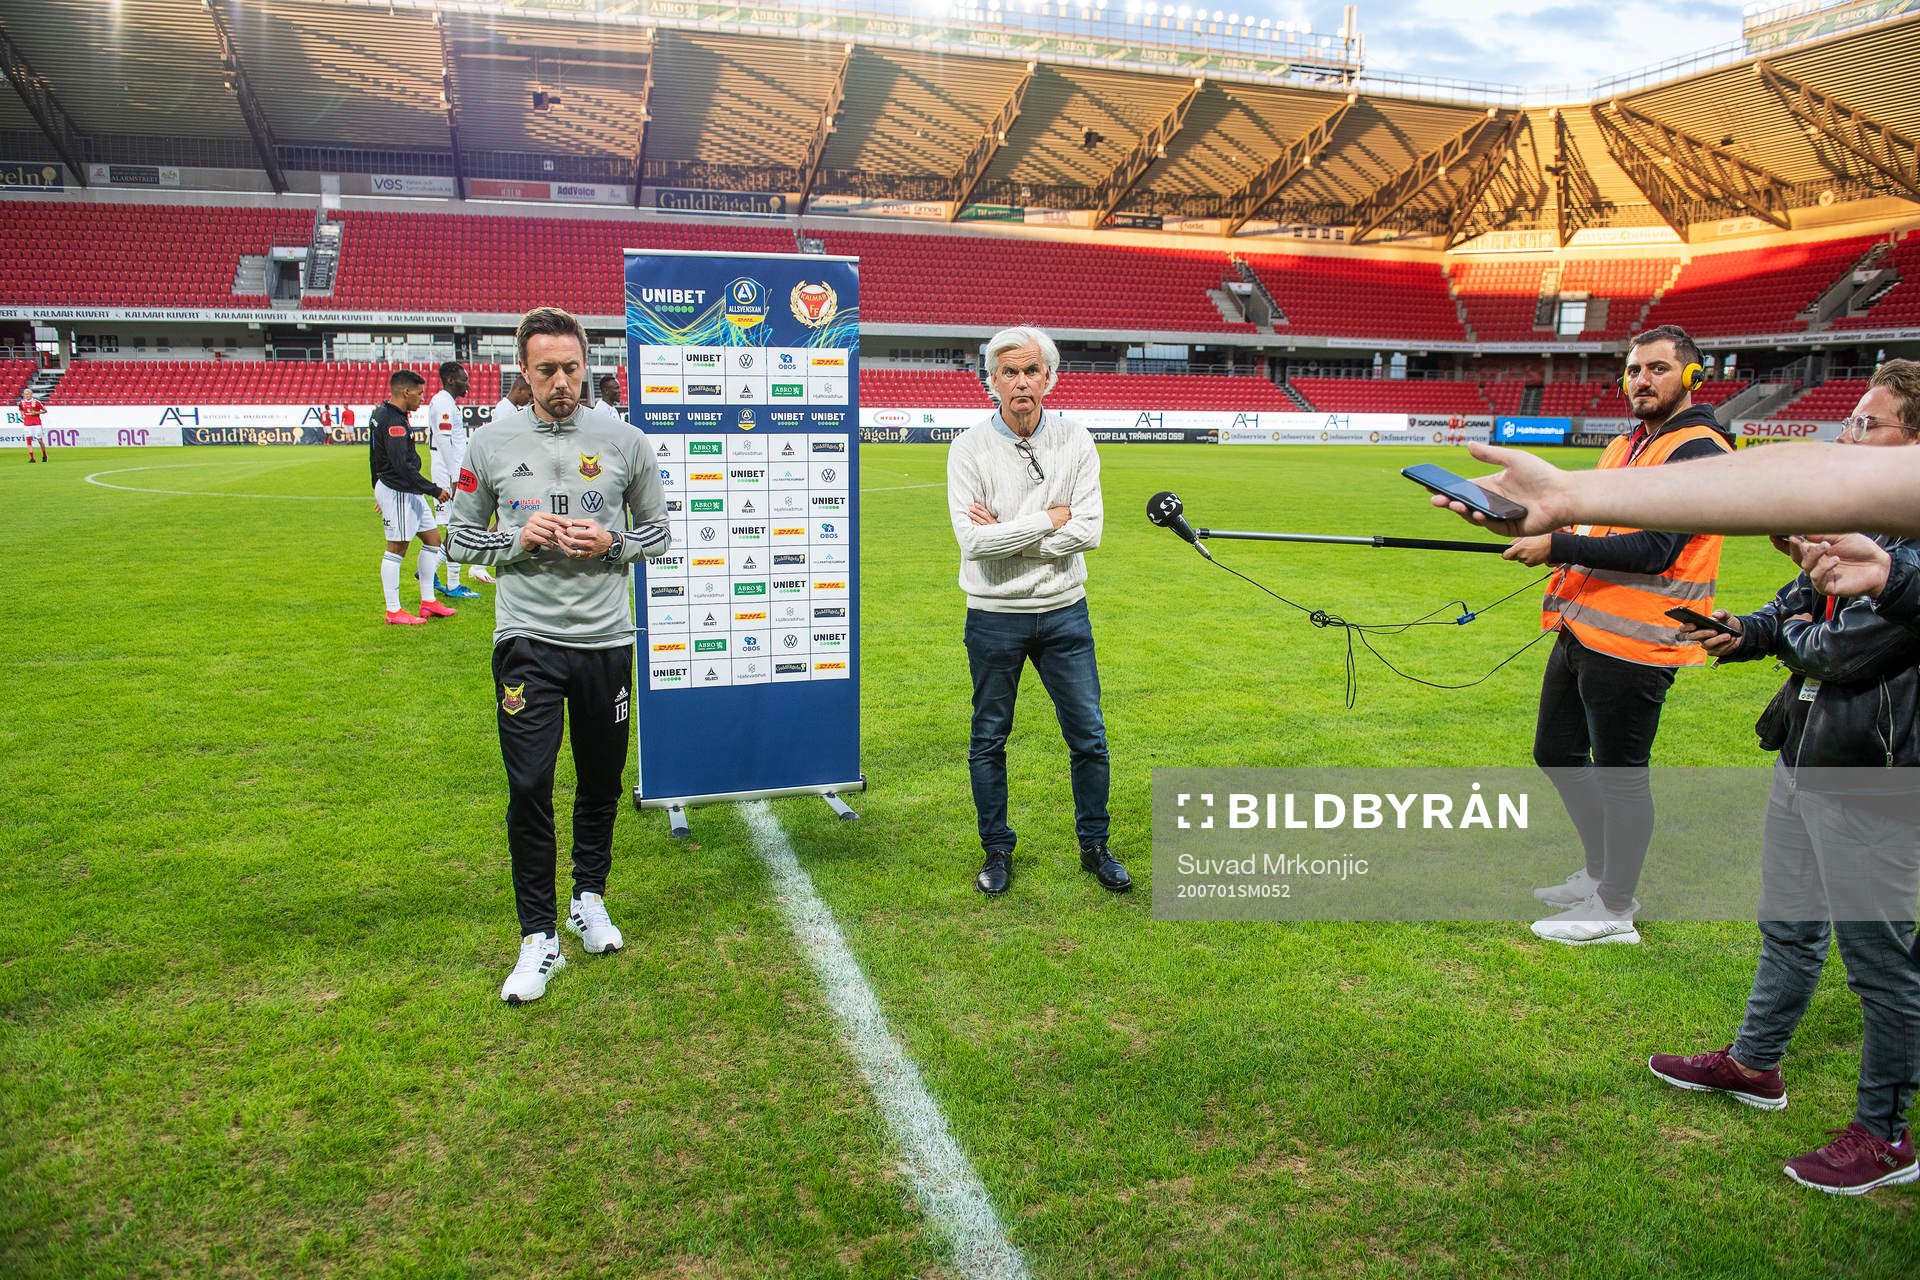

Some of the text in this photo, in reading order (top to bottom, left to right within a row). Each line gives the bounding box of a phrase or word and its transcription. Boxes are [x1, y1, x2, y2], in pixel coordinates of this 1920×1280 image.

[557, 185, 595, 196] AddVoice
[660, 192, 767, 214] GuldFågeln
[642, 288, 706, 304] UNIBET
[728, 305, 762, 313] ALLSVENSKAN
[33, 310, 110, 318] KALMAR KUVERT
[125, 311, 164, 319] KALMAR
[686, 354, 722, 362] UNIBET
[160, 407, 200, 426] AH
[645, 412, 680, 421] UNIBET
[687, 412, 723, 421] UNIBET
[770, 412, 805, 421] UNIBET
[811, 412, 846, 421] UNIBET
[1135, 412, 1163, 428] AH
[1232, 413, 1259, 428] AH
[1742, 423, 1818, 437] SHARP
[48, 430, 80, 446] ALT
[118, 430, 149, 446] ALT
[196, 428, 292, 445] GuldFågeln
[1112, 432, 1128, 441] ELM,
[1152, 433, 1166, 441] HOS
[1167, 433, 1185, 441] OSS!
[730, 470, 765, 478] UNIBET
[550, 494, 569, 515] IB
[812, 497, 845, 505] UNIBET
[731, 526, 766, 535] UNIBET
[649, 556, 684, 565] UNIBET
[773, 580, 806, 589] UNIBET
[813, 633, 846, 641] UNIBET
[652, 668, 688, 677] UNIBET
[614, 700, 628, 724] IB
